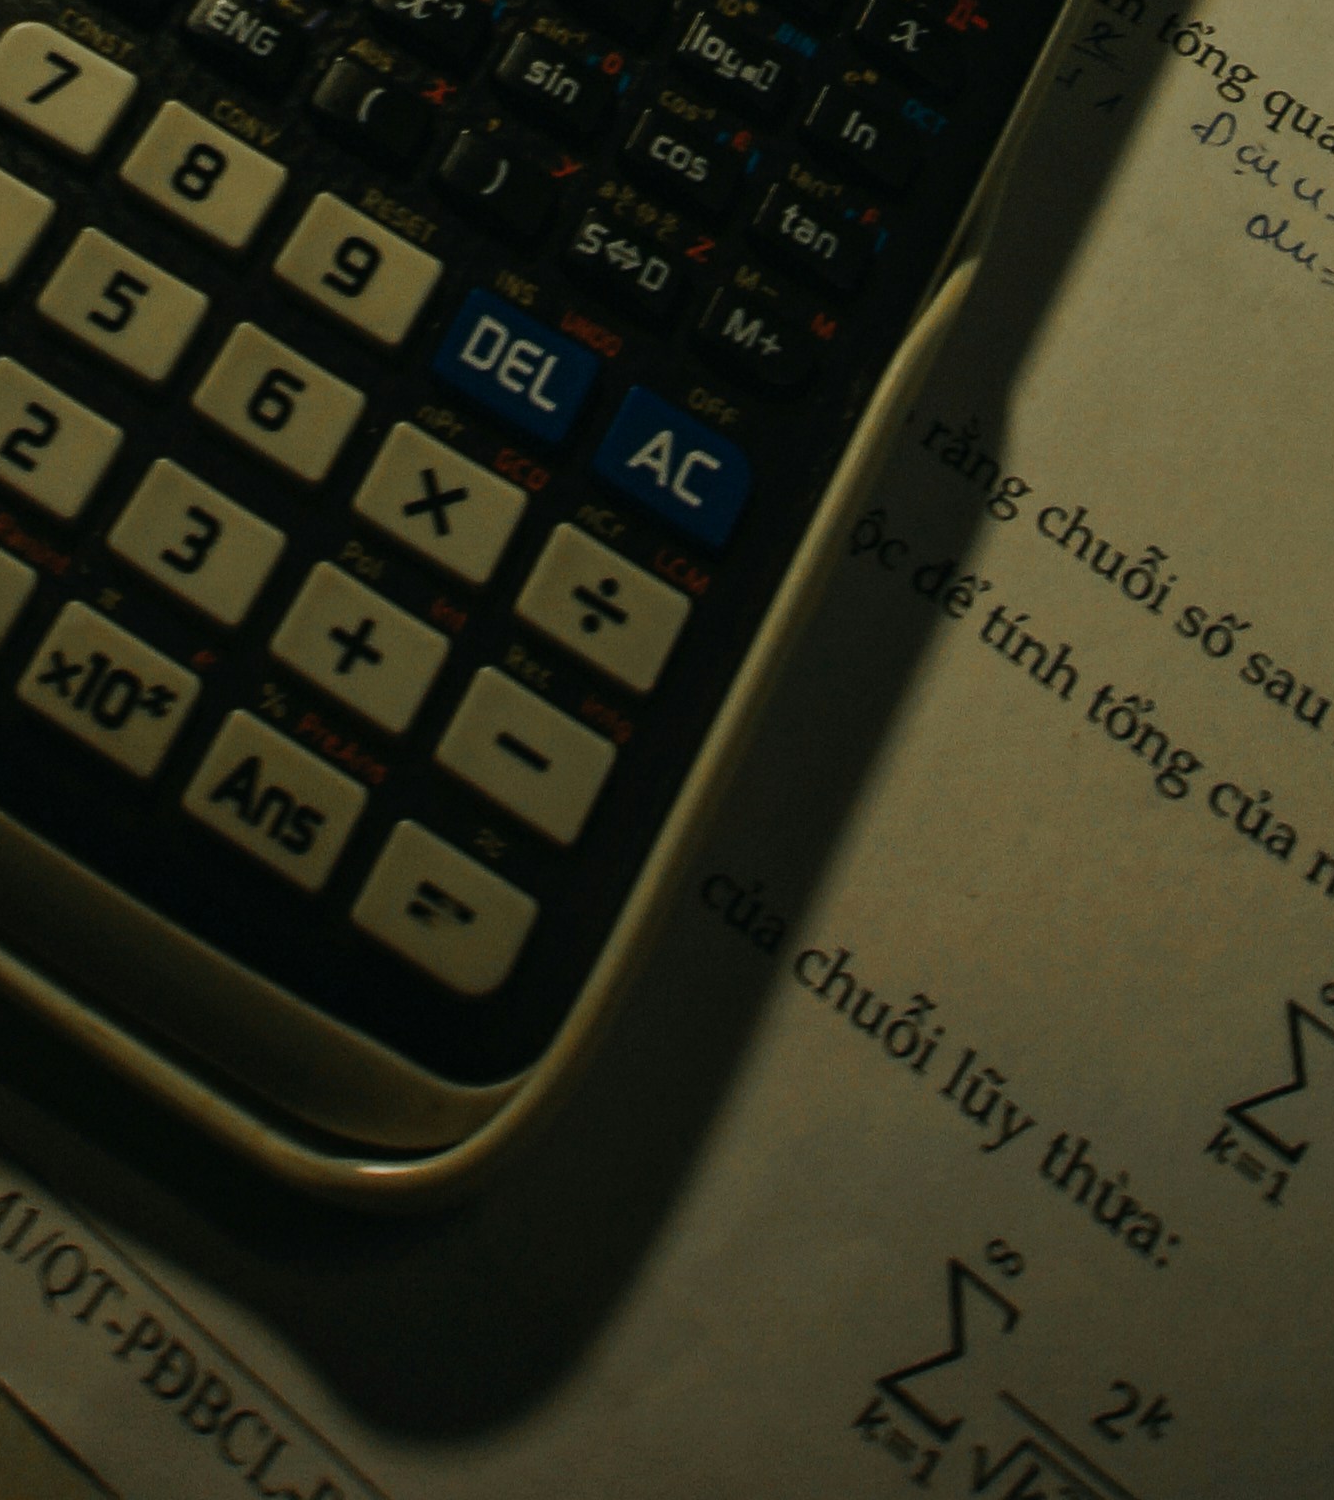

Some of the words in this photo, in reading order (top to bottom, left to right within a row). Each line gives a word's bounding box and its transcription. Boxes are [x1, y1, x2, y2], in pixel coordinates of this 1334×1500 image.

[26, 50, 83, 113] 7
[520, 54, 583, 107] sin
[1157, 10, 1260, 106] tổng
[646, 132, 711, 185] cos
[840, 108, 880, 152] ln
[168, 137, 226, 208] 8
[320, 229, 384, 300] 9
[777, 201, 841, 261] tan
[86, 266, 152, 337] 5
[245, 363, 305, 435] 6
[456, 309, 562, 416] DEL
[0, 397, 61, 474] 2
[621, 425, 728, 510] AC
[159, 500, 220, 577] 3
[919, 417, 1033, 523] rằng
[1035, 502, 1180, 616] chuỗi
[1173, 602, 1254, 660] số
[1239, 649, 1334, 731] sau
[911, 557, 994, 619] để
[978, 603, 1081, 701] tính
[1085, 682, 1204, 802] tổng
[1206, 778, 1301, 863] của
[208, 756, 327, 857] Ans
[697, 867, 791, 956] của
[791, 943, 948, 1077] chuỗi
[938, 1046, 1040, 1156] lũy
[1037, 1129, 1185, 1271] thừa:
